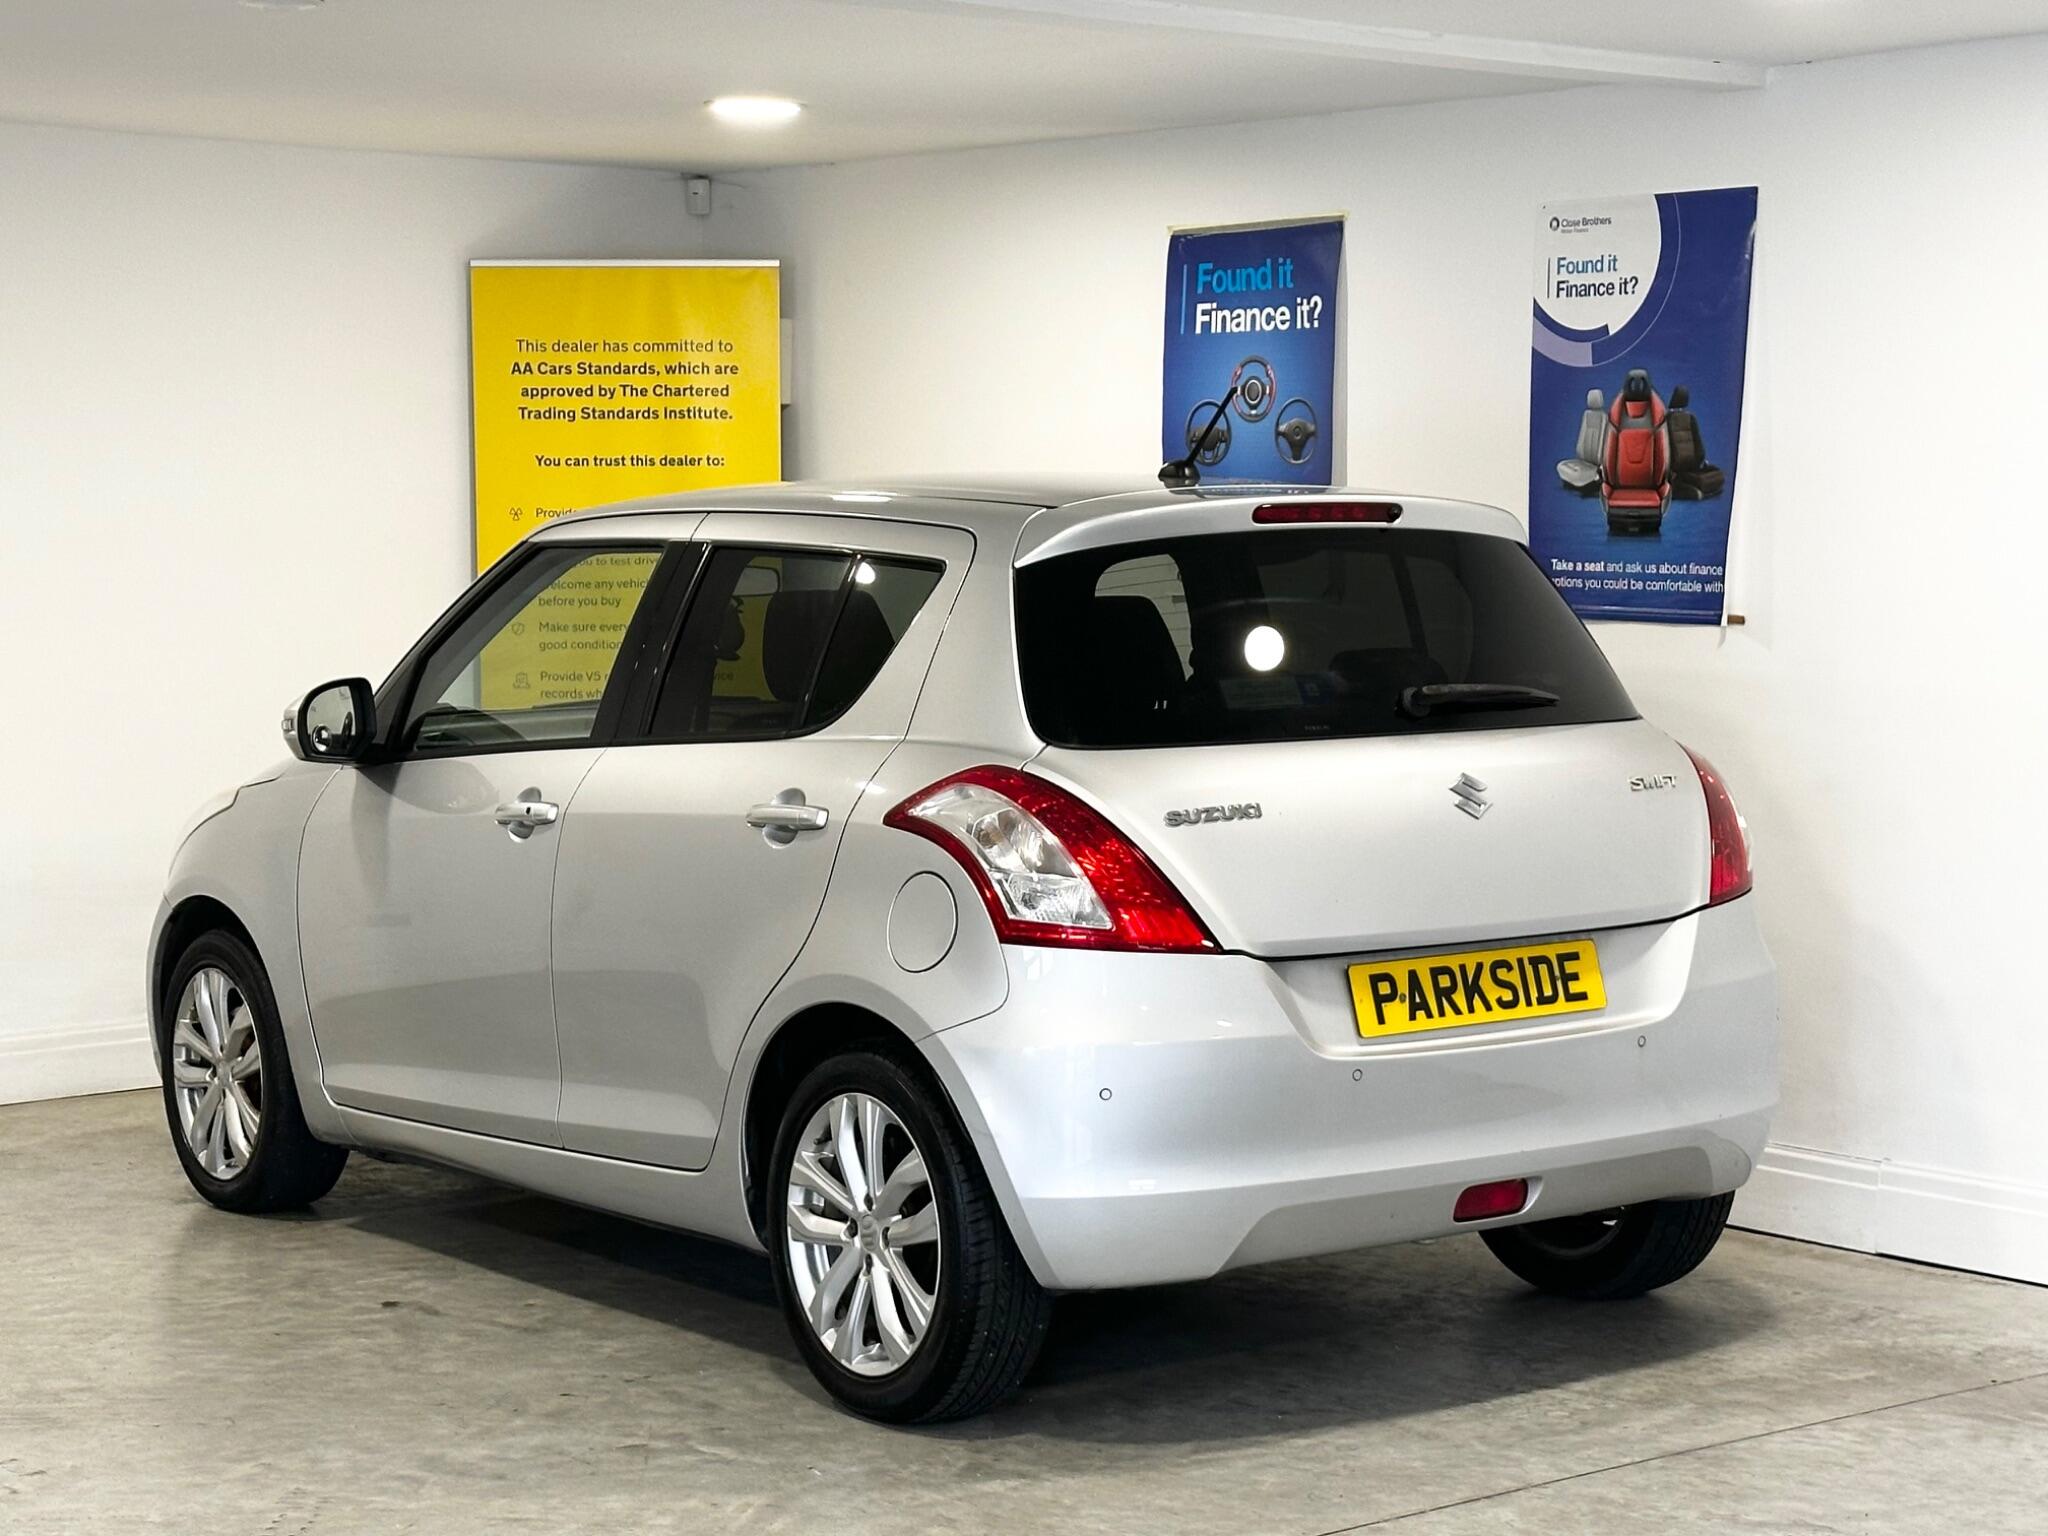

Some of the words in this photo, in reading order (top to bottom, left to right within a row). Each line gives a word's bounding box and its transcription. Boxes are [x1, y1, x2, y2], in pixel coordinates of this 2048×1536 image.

[1556, 255, 1604, 275] Found
[1607, 254, 1618, 272] it
[1196, 258, 1272, 294] Found
[1278, 257, 1294, 289] it
[1556, 278, 1615, 298] Finance
[1618, 276, 1639, 295] it?
[1195, 302, 1291, 334] Finance
[1296, 295, 1323, 330] it?
[516, 339, 547, 353] This
[552, 339, 600, 353] dealer
[603, 339, 629, 353] has
[633, 339, 714, 353] committed
[718, 341, 734, 353] to
[511, 362, 534, 375] AA
[537, 362, 573, 375] Cars
[577, 362, 661, 377] Standards,
[665, 362, 710, 375] which
[714, 364, 739, 375] are
[521, 384, 594, 399] approved
[598, 384, 616, 399] by
[619, 384, 649, 397] The
[652, 384, 730, 397] Chartered
[518, 406, 576, 422] Trading
[580, 406, 660, 420] Standards
[664, 406, 733, 420] Institute.
[535, 455, 561, 467] You
[565, 457, 589, 467] can
[592, 455, 626, 467] trust
[630, 455, 656, 467] this
[659, 455, 702, 467] dealer
[706, 456, 725, 467] to:
[634, 556, 658, 566] driv
[1551, 559, 1574, 571] Take
[1575, 562, 1583, 572] a
[1584, 560, 1605, 572] seat
[1606, 561, 1623, 573] and
[1625, 562, 1642, 574] ask
[1644, 564, 1657, 574] us
[1659, 562, 1687, 575] about
[1689, 563, 1723, 576] finance
[594, 581, 614, 591] any
[1585, 579, 1601, 591] you
[1603, 577, 1629, 590] could
[1630, 579, 1644, 590] be
[1645, 579, 1702, 592] comfortable
[538, 595, 576, 607] before
[577, 597, 598, 609] you
[601, 596, 622, 608] buy
[539, 621, 570, 633] Make
[572, 623, 597, 633] sure
[539, 640, 568, 652] good
[540, 670, 584, 682] Provide
[586, 671, 601, 681] V5
[541, 689, 584, 699] records
[1163, 802, 1263, 827] SUZUKI
[1369, 951, 1589, 1025] PARKSIDE
